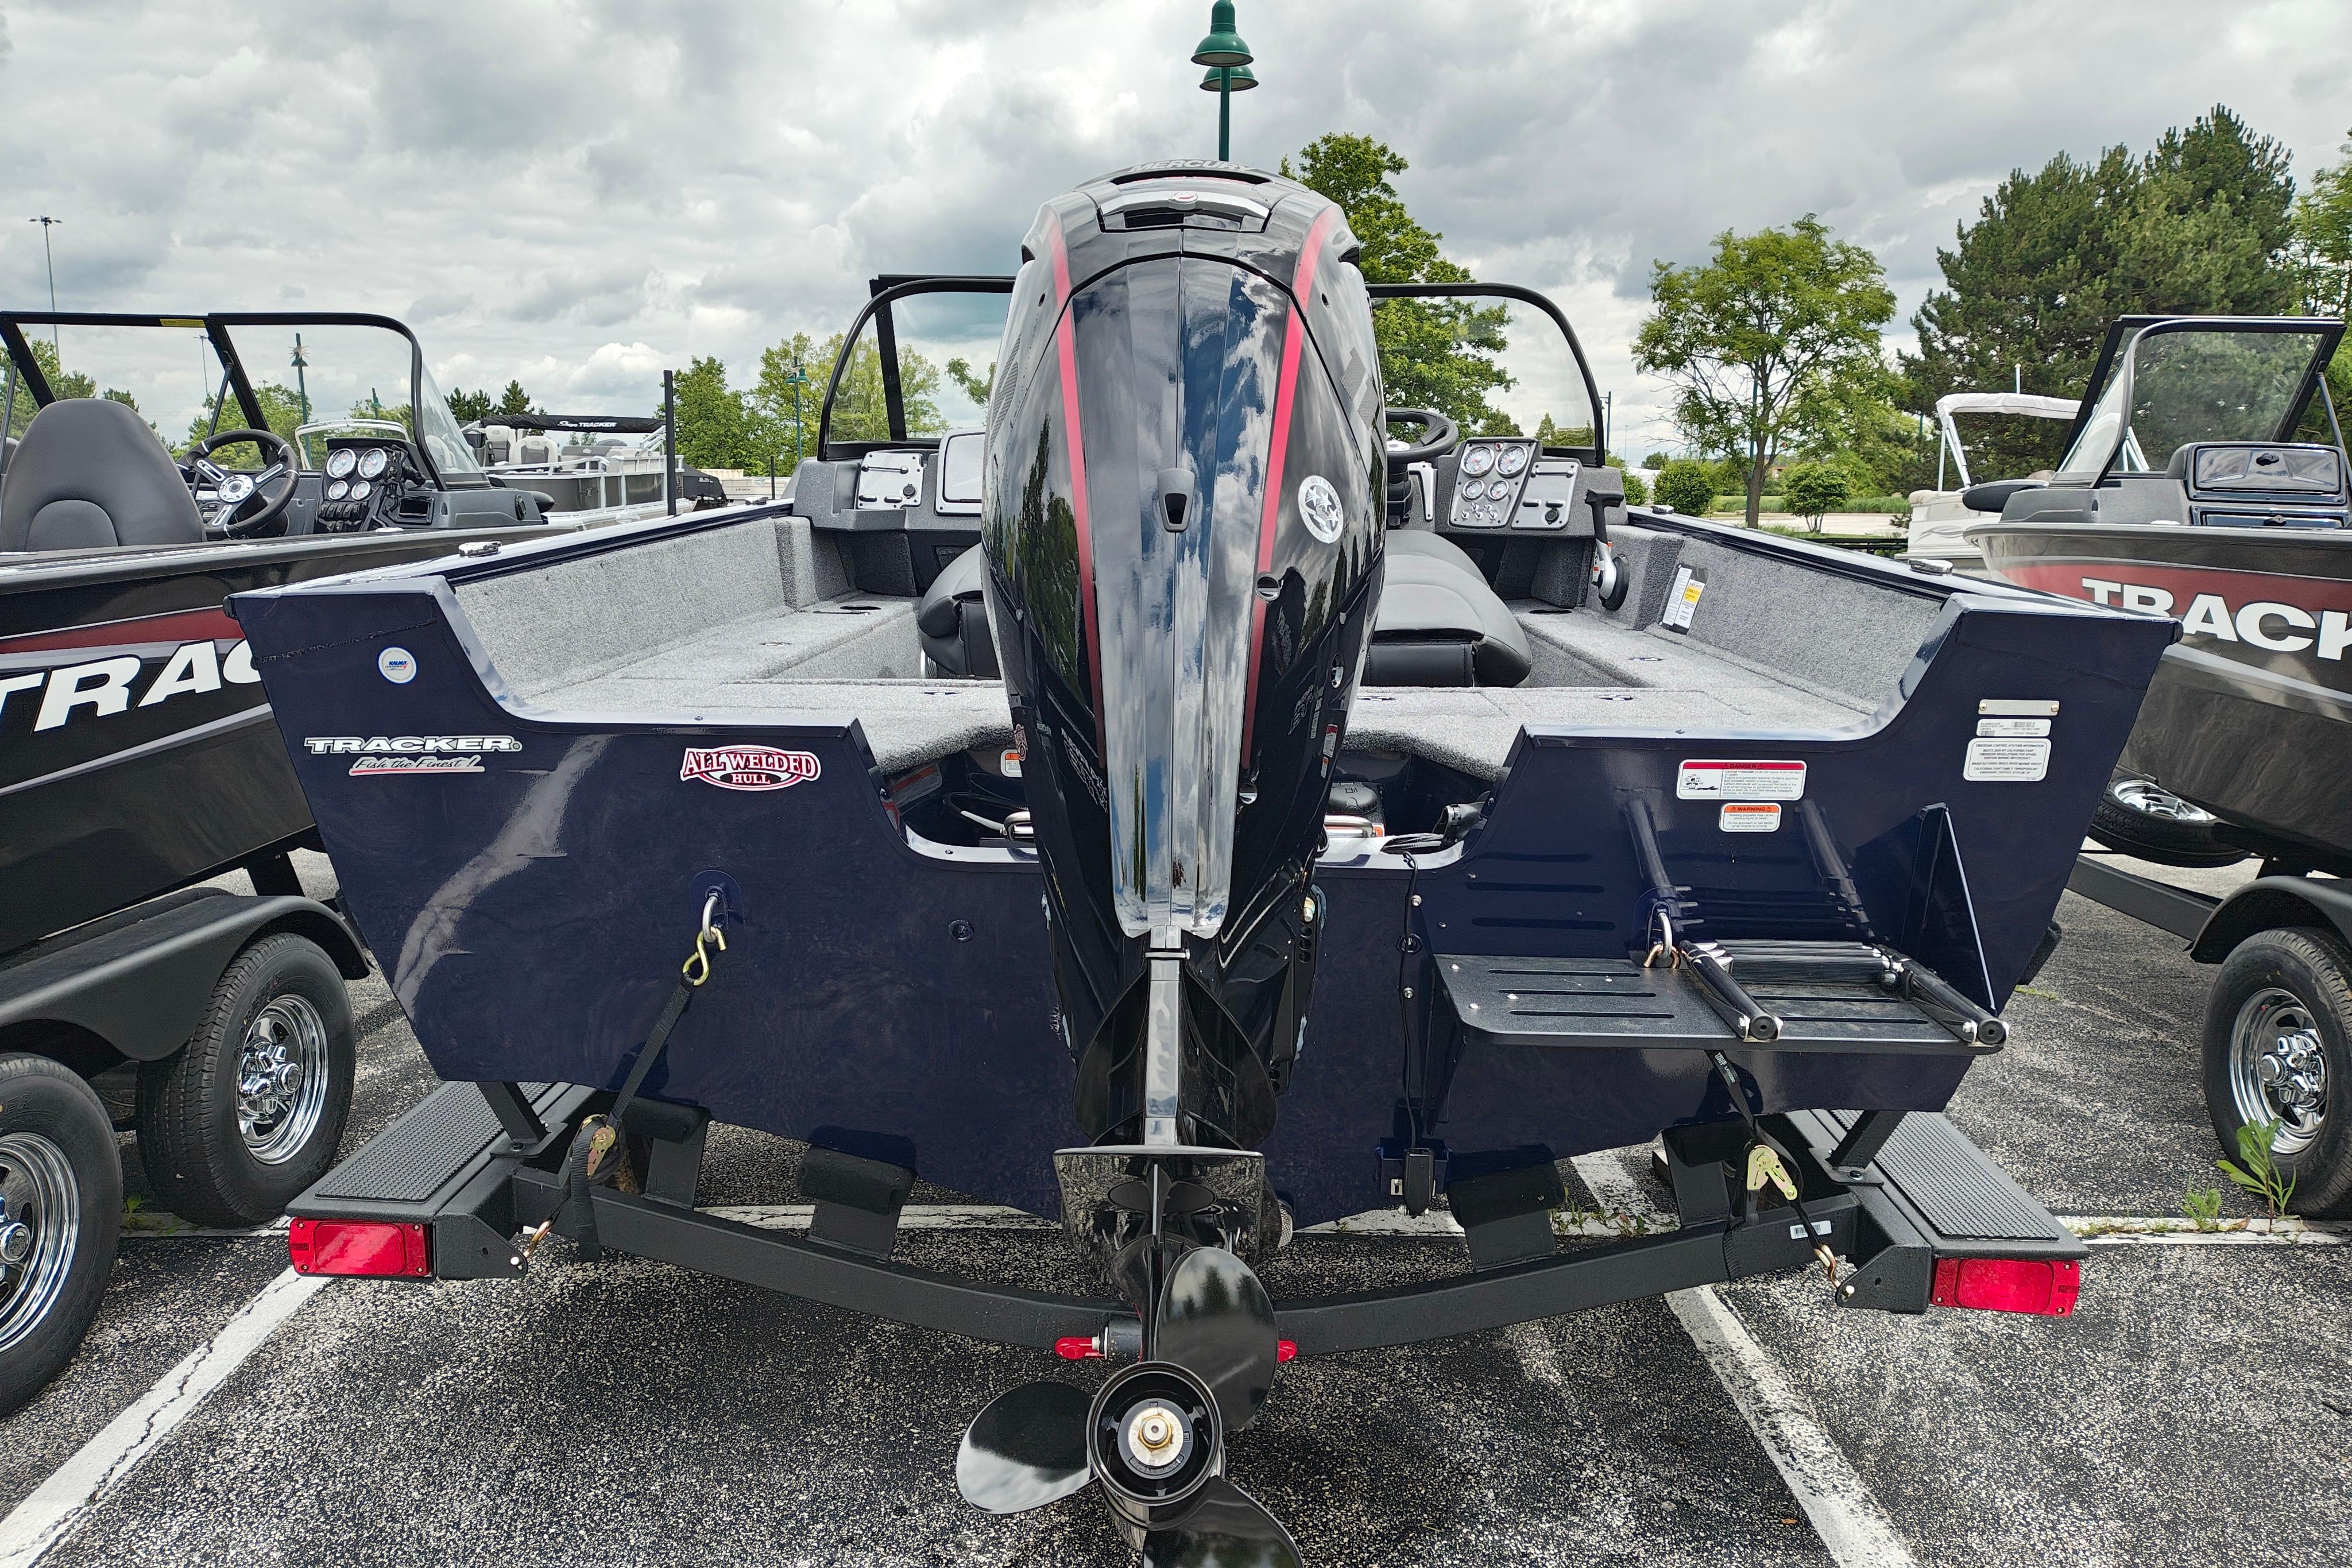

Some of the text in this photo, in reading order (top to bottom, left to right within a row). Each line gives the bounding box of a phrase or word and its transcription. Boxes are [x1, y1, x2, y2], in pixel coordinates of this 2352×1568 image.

[1129, 160, 1254, 173] MERCURY
[307, 738, 513, 752] TRACKER
[355, 758, 388, 769] Fish
[389, 760, 413, 768] the
[684, 752, 817, 777] ALL WELDED
[731, 773, 771, 784] HULL
